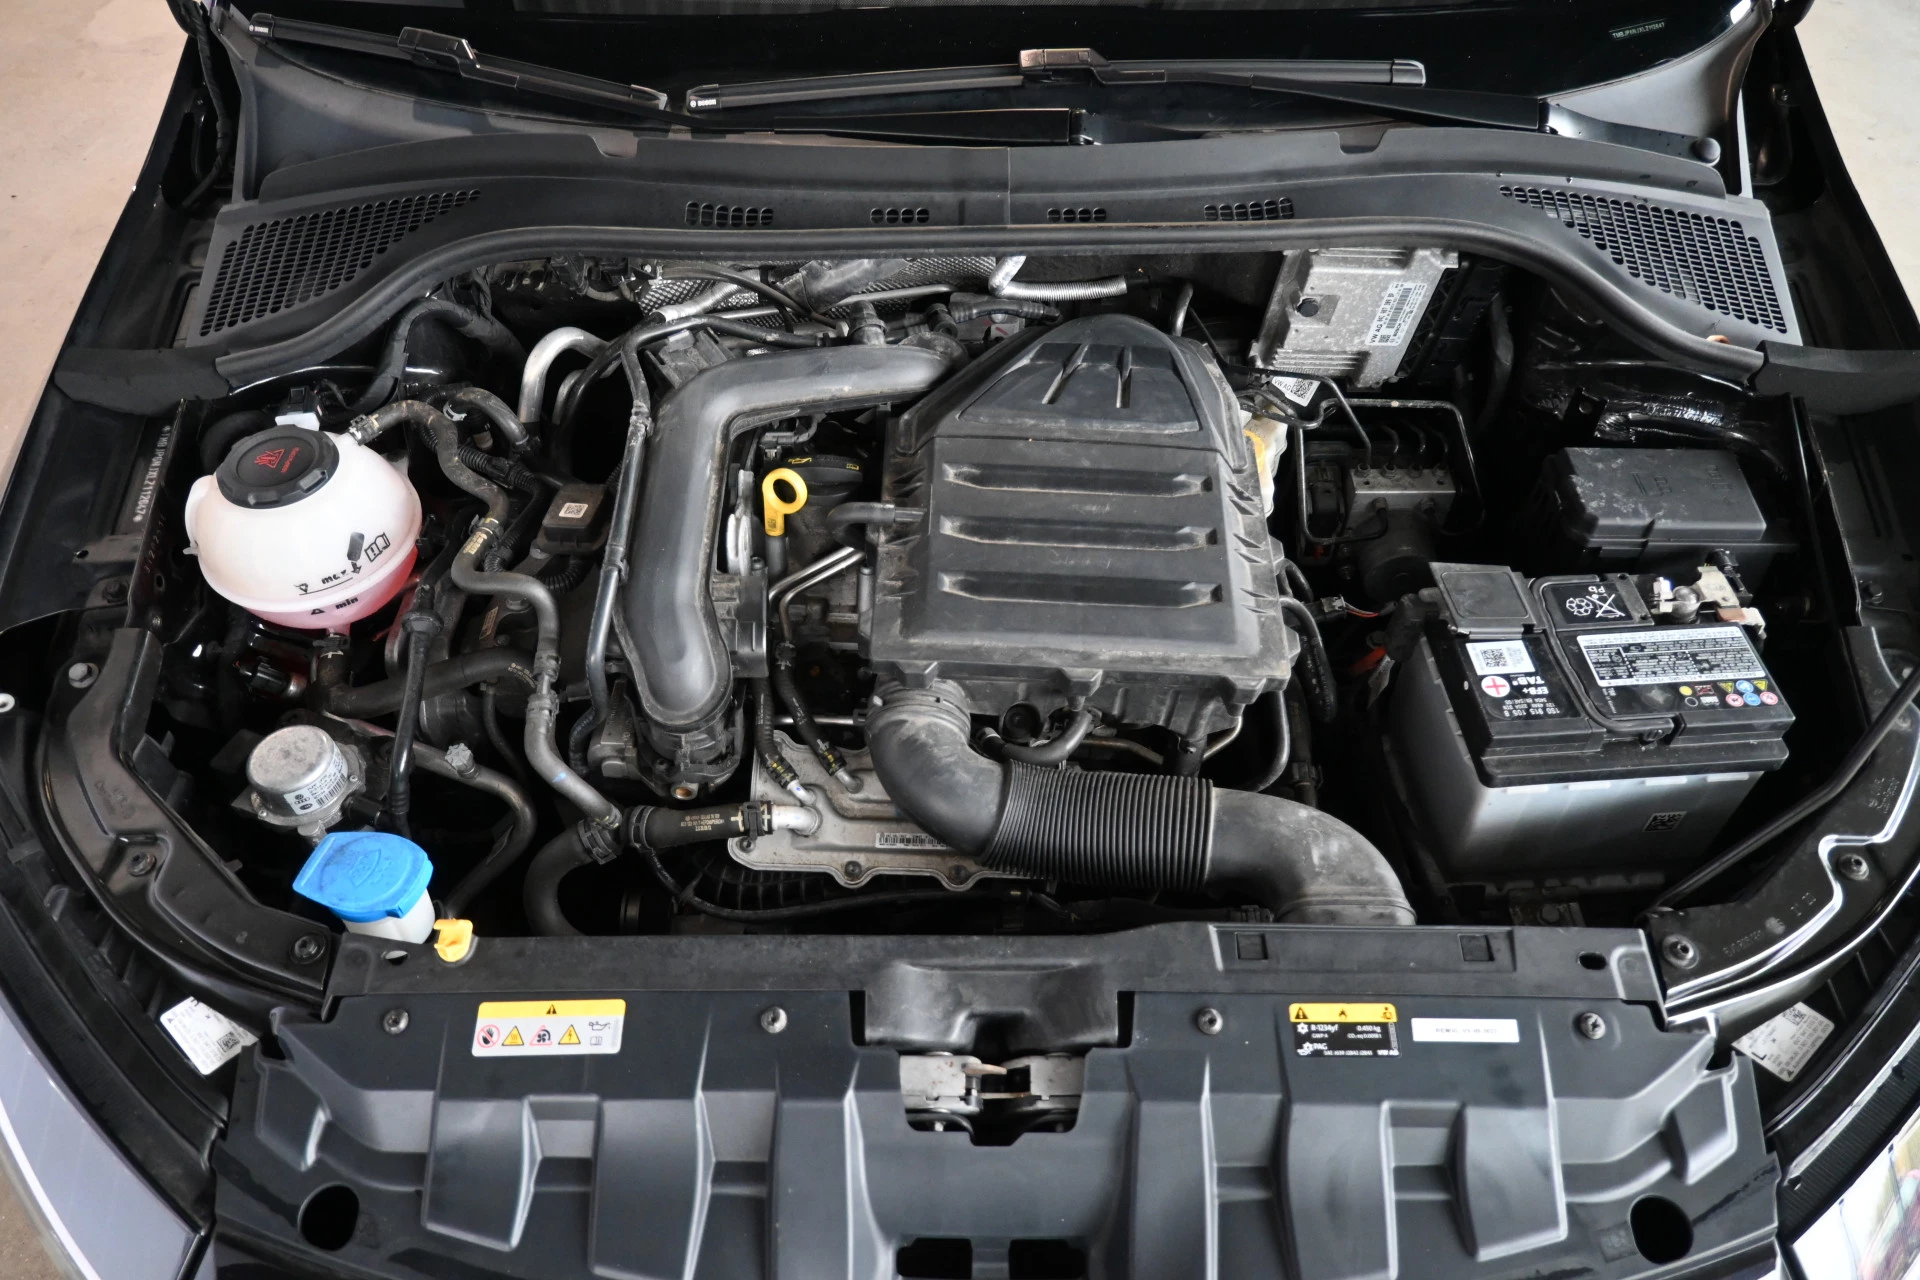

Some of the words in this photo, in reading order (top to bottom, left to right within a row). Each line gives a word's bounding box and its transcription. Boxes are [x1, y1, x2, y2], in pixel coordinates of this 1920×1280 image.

[1588, 585, 1606, 593] Pb
[335, 597, 359, 609] min
[1522, 686, 1548, 694] EFB+
[1310, 1024, 1338, 1033] R-1234yf
